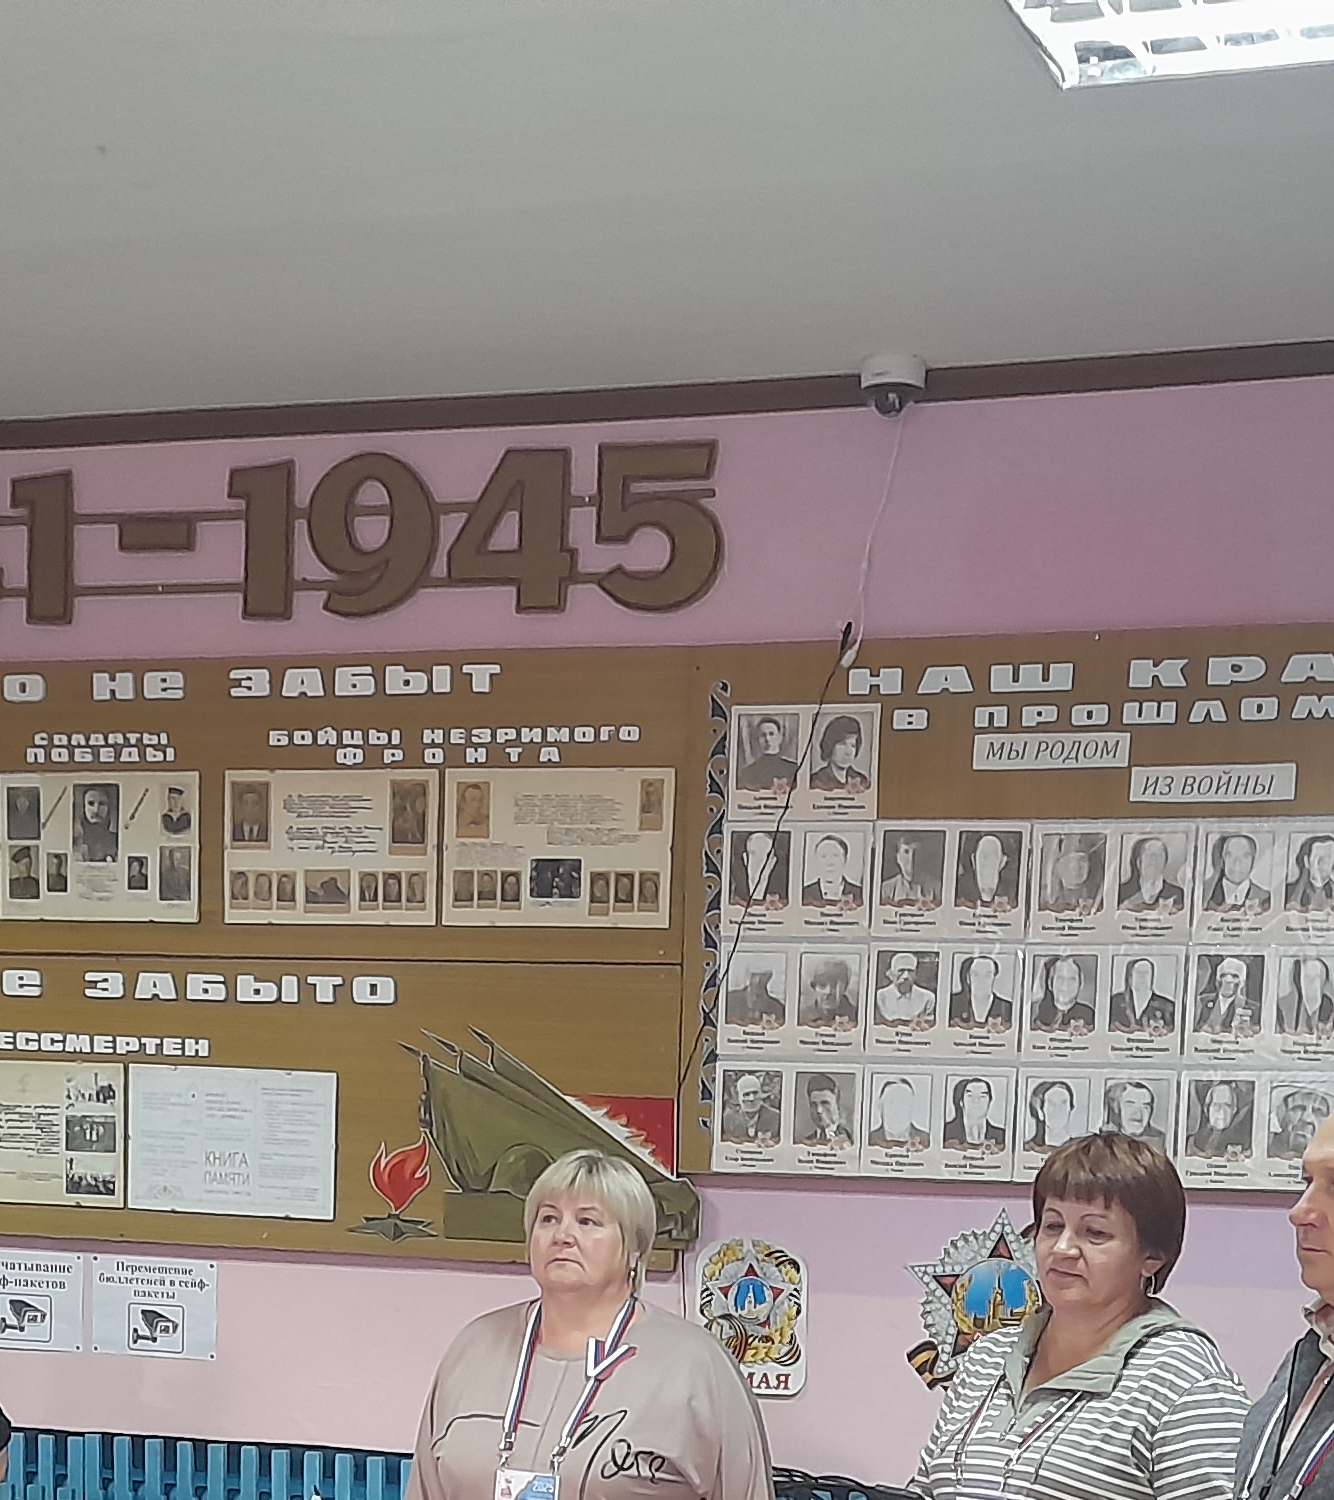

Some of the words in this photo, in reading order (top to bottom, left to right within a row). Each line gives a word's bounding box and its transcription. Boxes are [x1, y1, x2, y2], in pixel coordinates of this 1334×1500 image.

[227, 663, 503, 699] ЗАБЫТ
[847, 661, 1075, 696] НАШ
[33, 731, 169, 747] СОЛДАТЫ
[267, 726, 402, 747] БОЙЦЫ
[421, 724, 643, 745] НЕЗРИМОГО
[25, 746, 177, 764] ПОБЕДЫ
[985, 740, 1029, 761] МЫ
[1035, 738, 1121, 764] РОДОМ
[1141, 774, 1175, 797] ИЗ
[1180, 771, 1276, 796] ВОЙНЫ
[83, 969, 399, 1006] ЗАБЫТО
[203, 1151, 250, 1168] КНИГА
[203, 1169, 251, 1187] ПАМЯТИ
[115, 1260, 194, 1276] Перемещение
